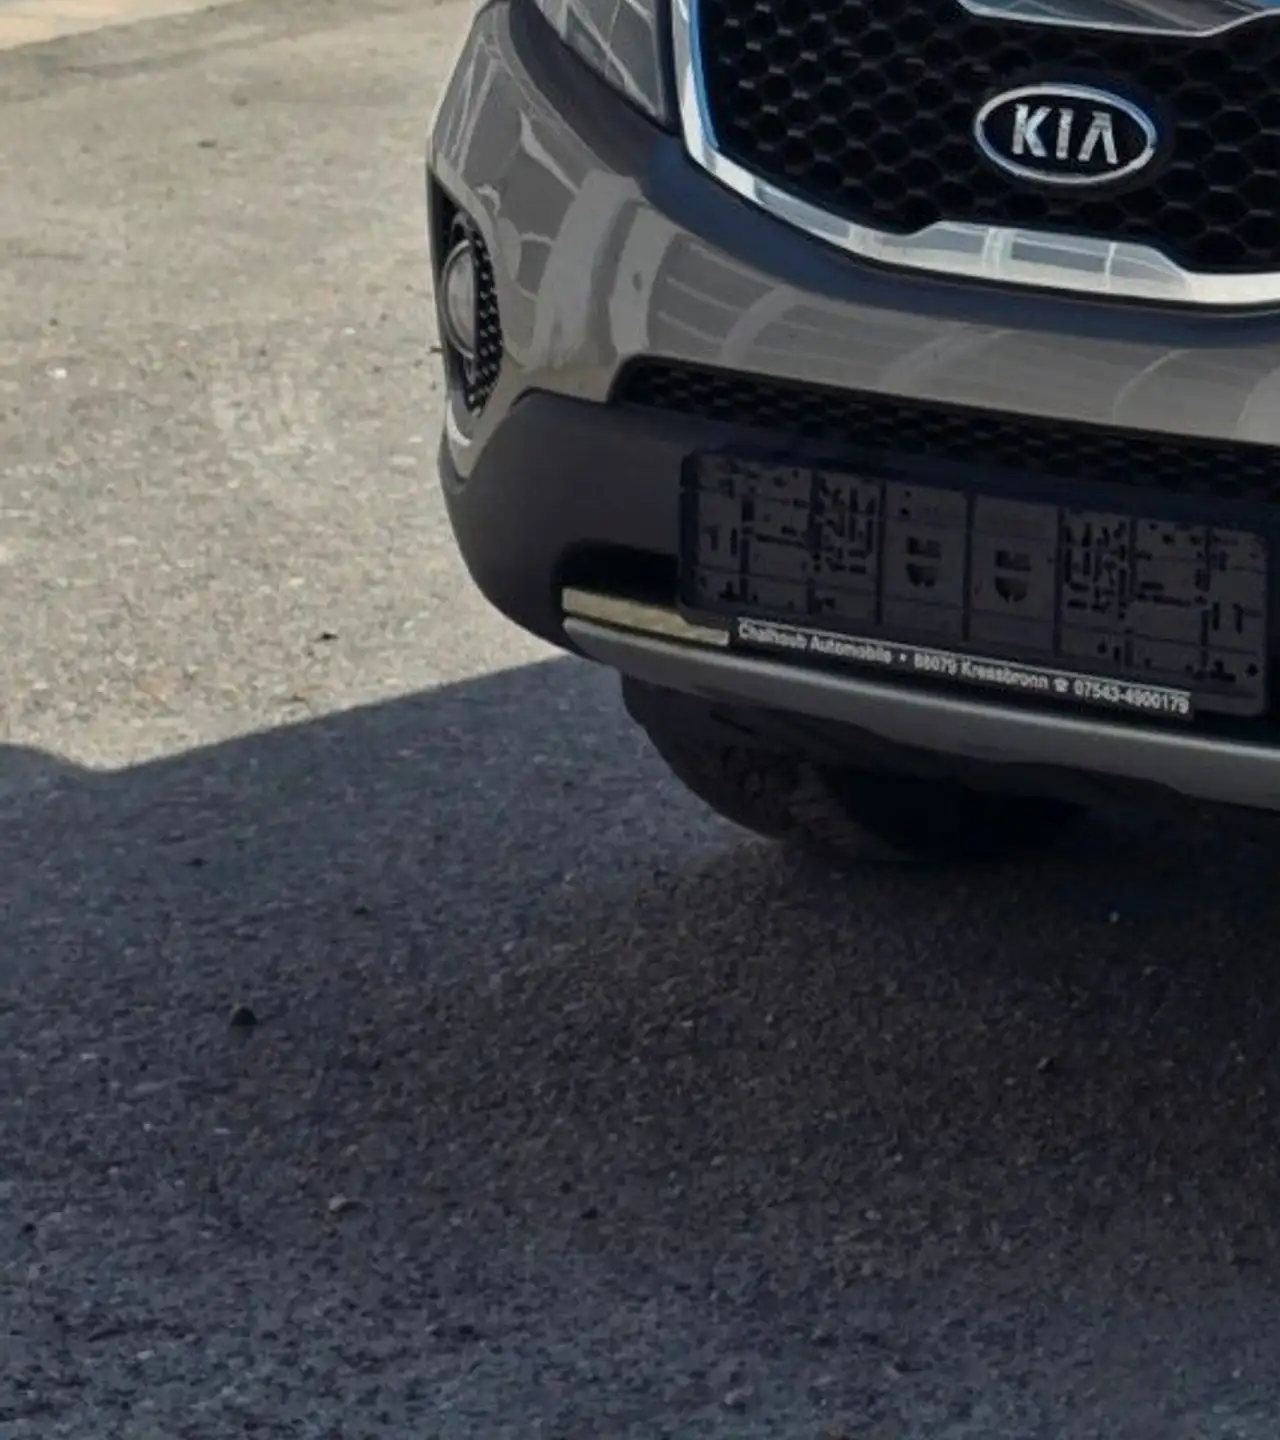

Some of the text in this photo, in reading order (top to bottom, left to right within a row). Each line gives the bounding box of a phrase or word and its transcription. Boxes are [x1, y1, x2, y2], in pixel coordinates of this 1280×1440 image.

[1011, 102, 1119, 165] KIA
[810, 634, 893, 665] Automobile
[960, 659, 1050, 690] Kressbronn
